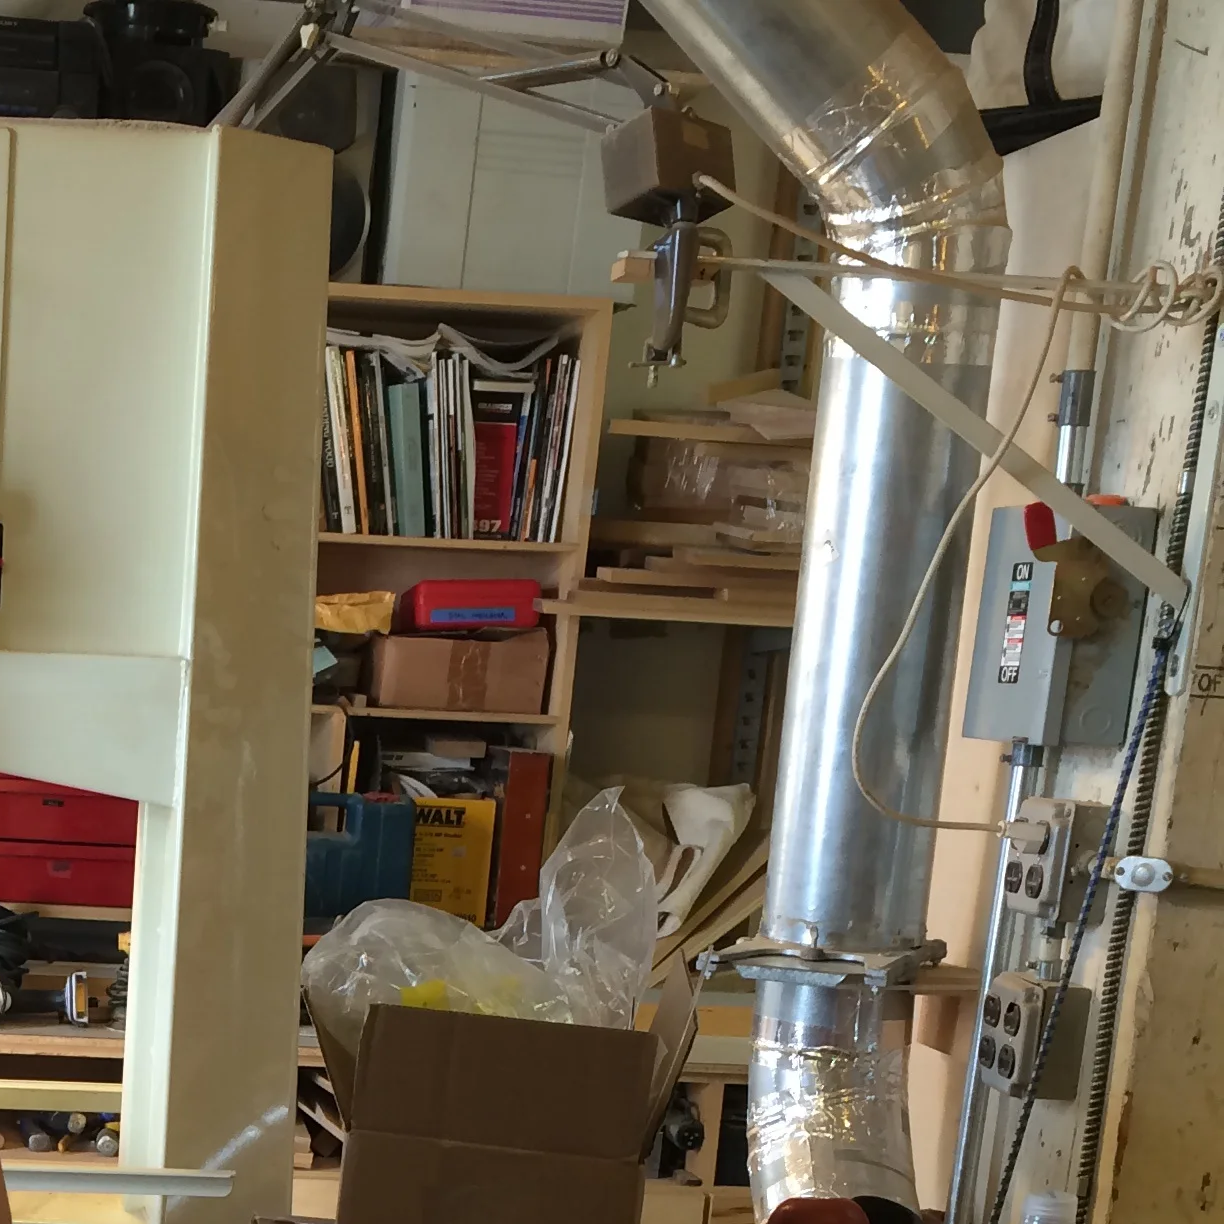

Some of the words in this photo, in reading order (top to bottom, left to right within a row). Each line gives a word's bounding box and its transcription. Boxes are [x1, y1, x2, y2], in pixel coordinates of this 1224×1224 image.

[1015, 563, 1030, 580] ON
[1001, 666, 1018, 682] OFF
[416, 807, 466, 826] WALT
